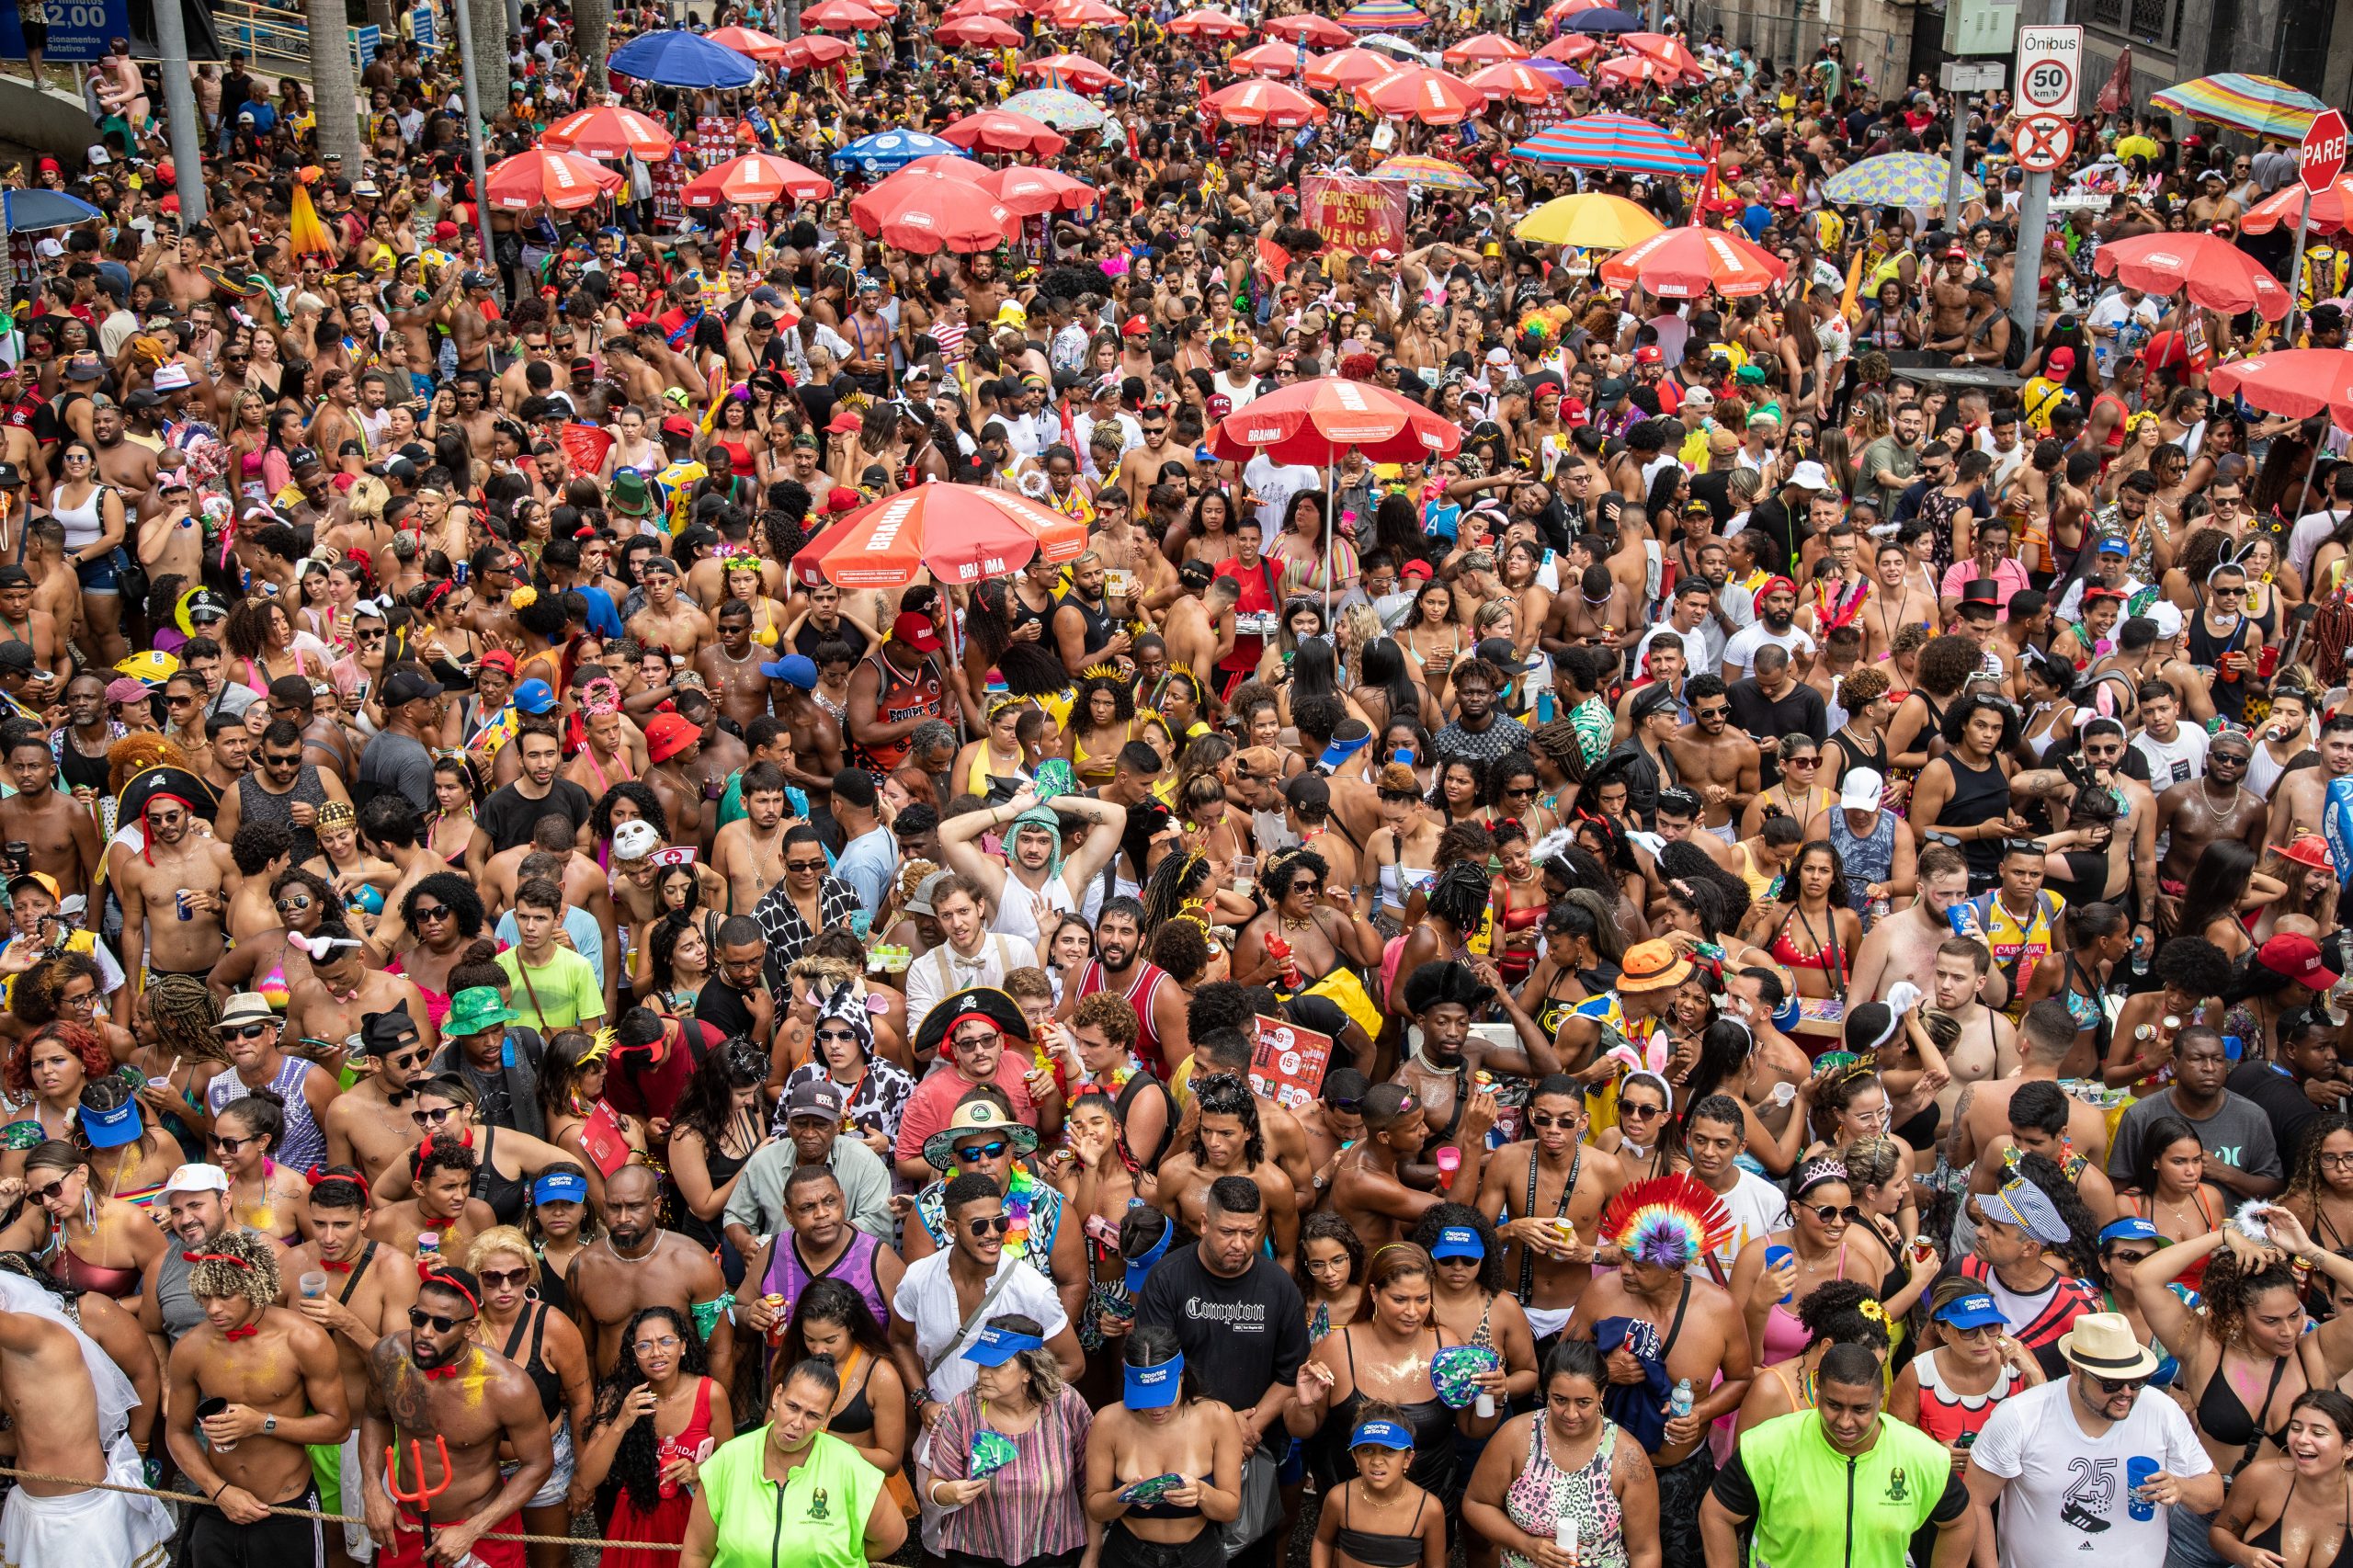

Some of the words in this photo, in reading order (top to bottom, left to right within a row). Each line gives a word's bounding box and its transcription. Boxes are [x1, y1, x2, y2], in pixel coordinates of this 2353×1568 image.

[48, 36, 101, 44] cionamentos
[48, 44, 86, 52] Rotativos
[2024, 33, 2076, 51] Ônibus
[1368, 73, 1404, 94] BRAHMA
[2033, 69, 2063, 87] 50
[2033, 89, 2059, 98] km/h
[2302, 136, 2344, 168] PARE
[504, 198, 528, 208] BRAHMA
[1336, 208, 1366, 223] DAS
[1623, 235, 1672, 267] BRAHMA
[1658, 284, 1688, 295] BRAHMA
[1213, 398, 1230, 407] FFC
[1247, 426, 1280, 442] BRAHMA
[1422, 431, 1445, 448] BRAHMA
[974, 488, 1055, 528] BRAHMA
[865, 496, 920, 551] BRAHMA
[1276, 1033, 1284, 1042] 8
[1282, 1057, 1293, 1068] 15
[1848, 1053, 1877, 1074] MEL
[1292, 1093, 1302, 1104] 10
[1186, 1296, 1266, 1324] Compton
[1140, 1369, 1167, 1380] esportes
[2067, 1458, 2118, 1501] 25
